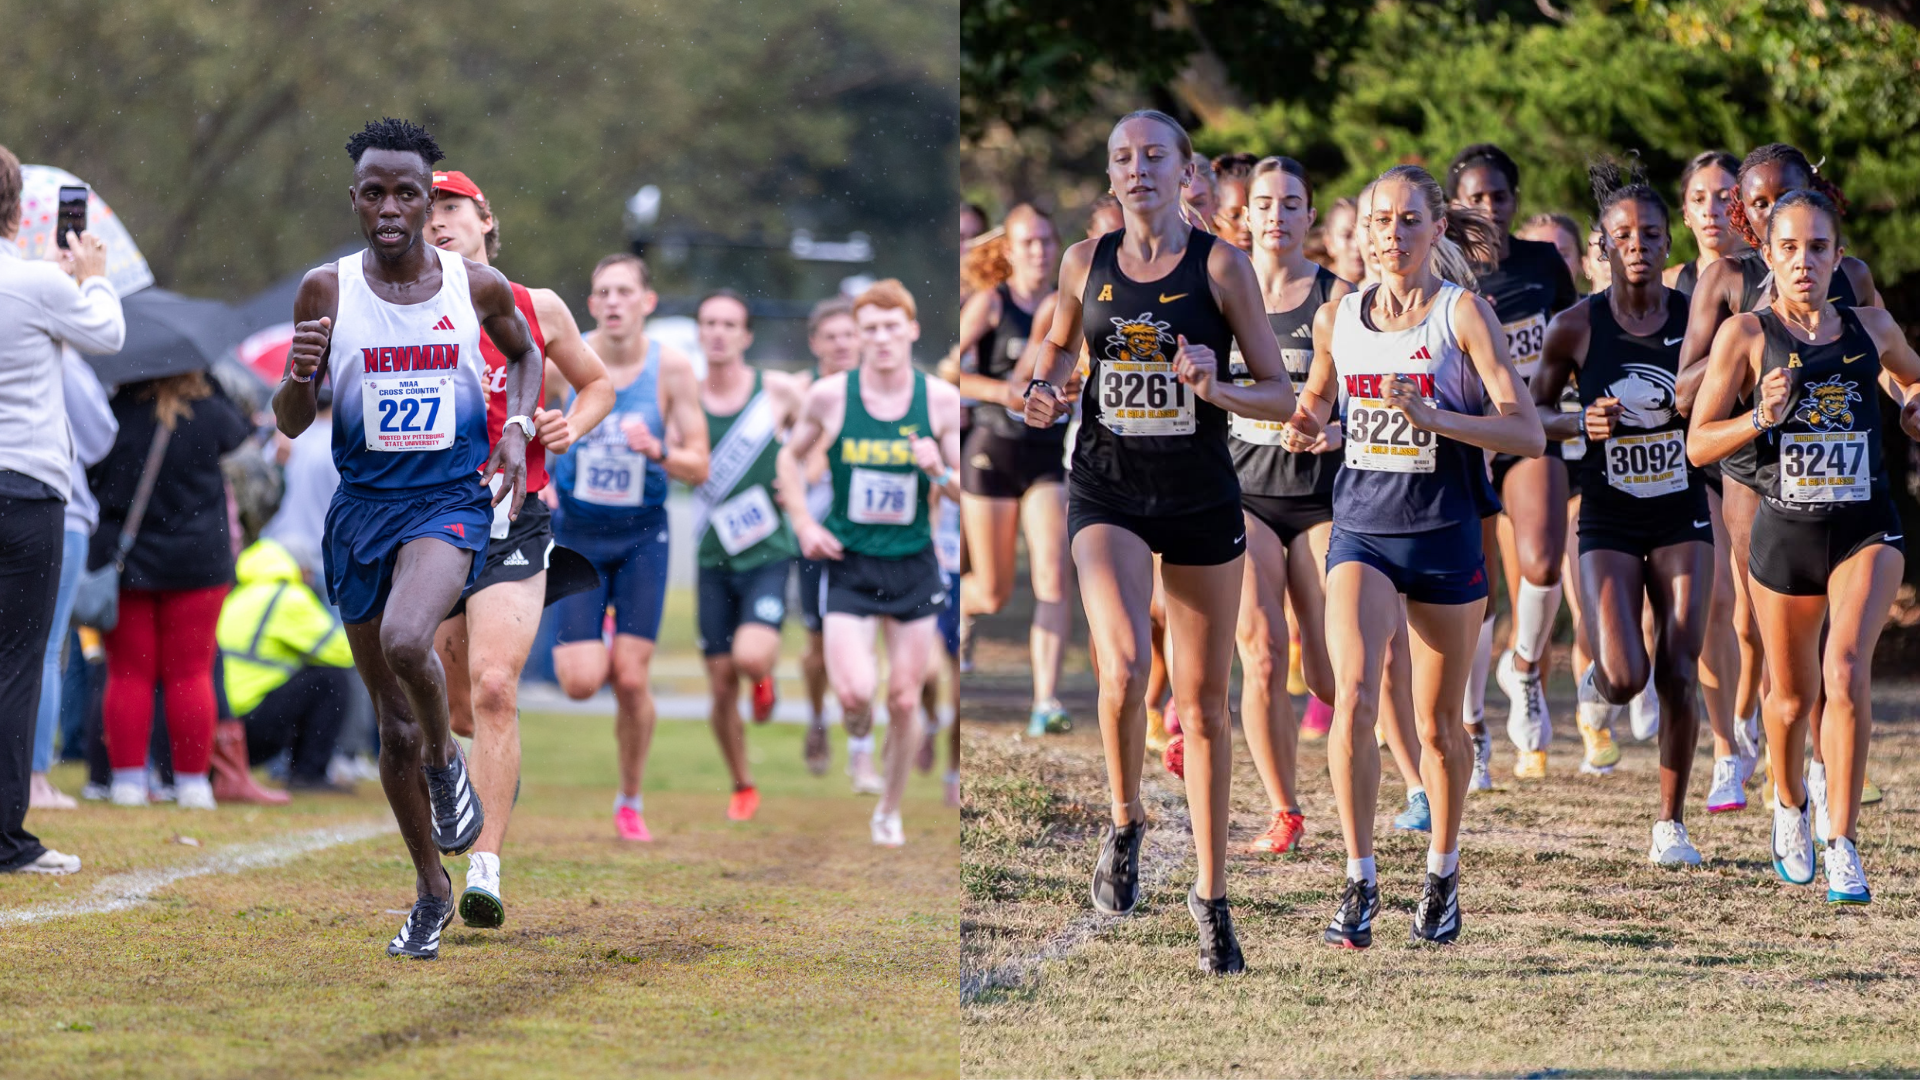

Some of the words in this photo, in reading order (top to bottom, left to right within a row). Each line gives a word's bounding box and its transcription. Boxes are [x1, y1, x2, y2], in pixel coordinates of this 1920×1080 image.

[1097, 284, 1113, 301] A
[360, 344, 460, 373] NEWMAN
[1788, 353, 1803, 368] A
[405, 387, 439, 395] COUNTRY
[1104, 372, 1184, 408] 3261
[1344, 373, 1435, 399] NEWN
[378, 397, 441, 432] 227
[842, 438, 918, 465] MSS
[1611, 440, 1682, 475] 3092
[1785, 443, 1864, 477] 3247
[587, 467, 630, 491] 320
